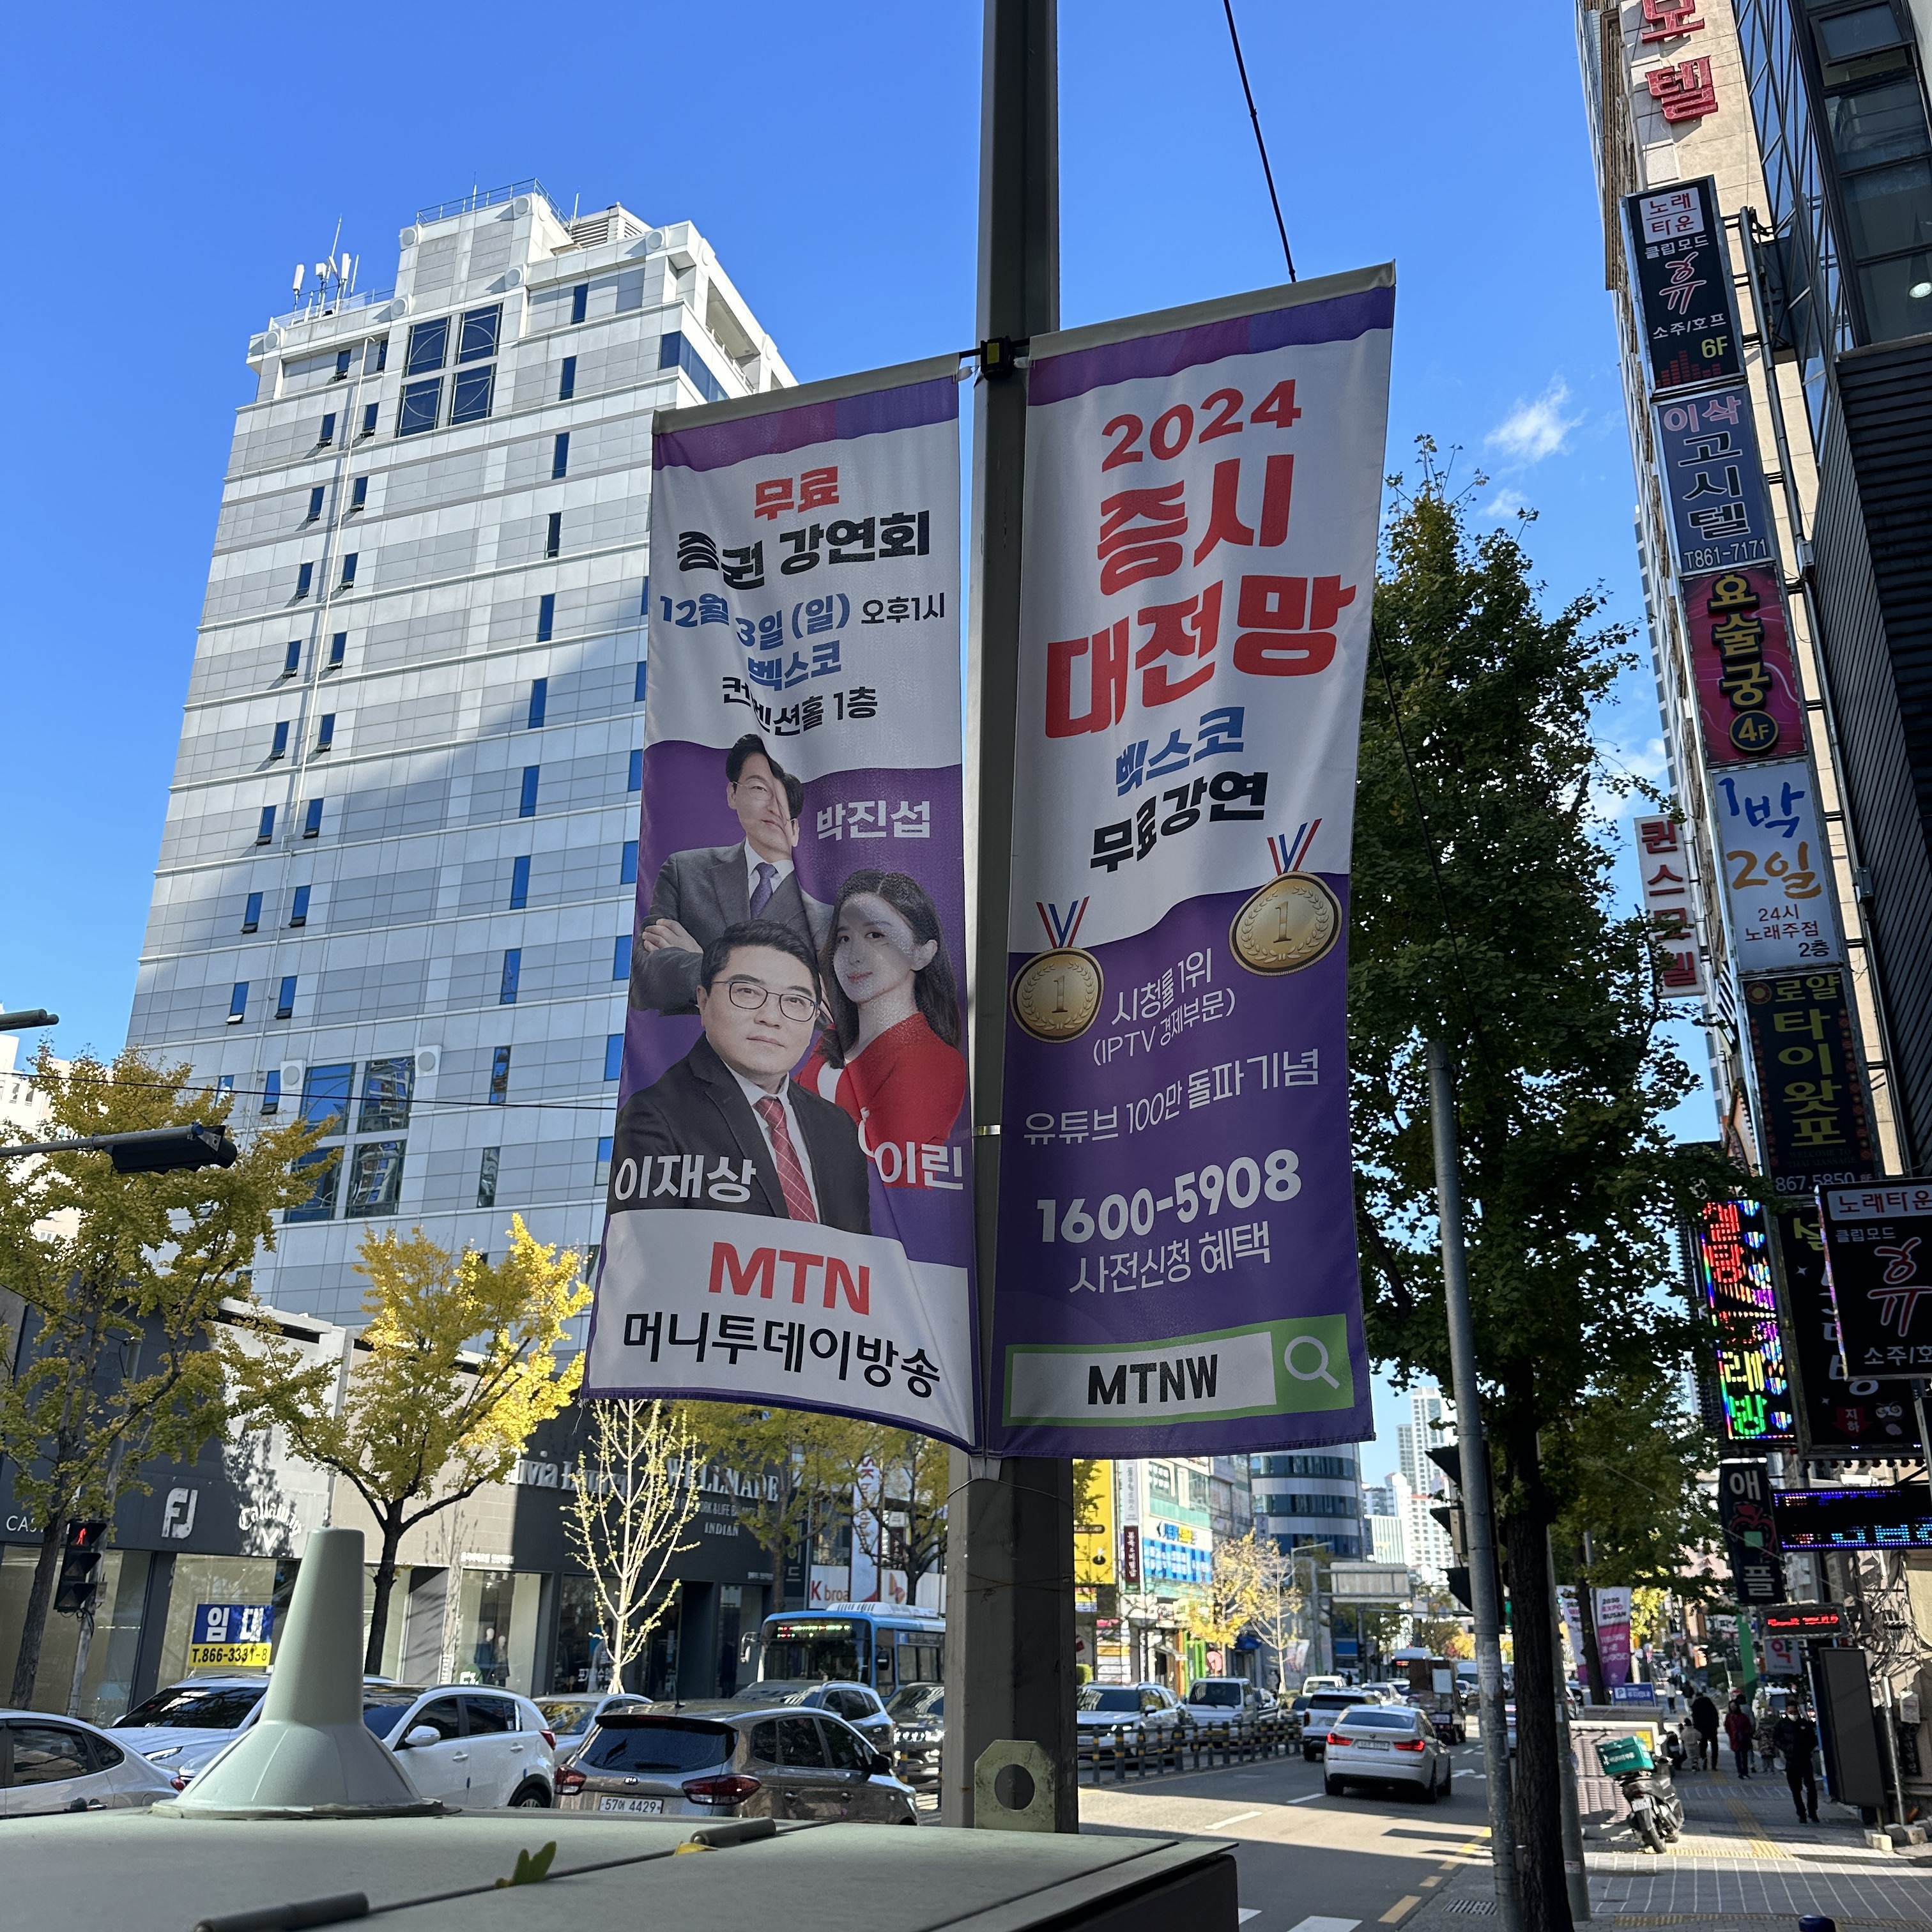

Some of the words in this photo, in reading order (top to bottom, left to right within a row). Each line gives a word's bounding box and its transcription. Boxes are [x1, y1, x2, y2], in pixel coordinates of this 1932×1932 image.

[1650, 192, 1692, 215] 노래
[1652, 216, 1694, 236] 타운
[1644, 234, 1710, 259] 클럽모드
[1653, 313, 1727, 340] 소주/호프
[1701, 335, 1728, 359] 6F
[1101, 379, 1301, 473] 2024
[1664, 395, 1742, 433] 이삭
[754, 466, 839, 521] 무료
[1678, 431, 1751, 542] 고시텔
[1097, 454, 1294, 595] 증시
[677, 531, 765, 590] 증권
[779, 510, 930, 575] 강연회
[1684, 539, 1767, 570] T861-7171
[660, 592, 730, 627] 12월
[736, 610, 784, 650] 3일
[792, 592, 850, 638] (일)
[861, 592, 945, 624] 오후1시
[1708, 573, 1772, 709] 요술궁
[747, 640, 842, 691] 벡스코
[1045, 574, 1356, 739] 대전망
[833, 686, 878, 721] 1층
[1116, 707, 1245, 797] 벡스코
[1738, 717, 1770, 742] 4F
[817, 800, 930, 841] 박진섭
[1718, 778, 1805, 838] 1박
[1726, 841, 1822, 900] 2일
[1275, 901, 1292, 944] 1
[1745, 920, 1819, 942] 노래주점
[1758, 903, 1800, 922] 24시
[1798, 940, 1830, 958] 2층
[1052, 975, 1068, 1014] 1
[1111, 967, 1174, 1026] 시청률
[1177, 948, 1212, 993] 1위
[1775, 975, 1841, 1002] 로얄
[1093, 1025, 1156, 1066] (IPTV
[1160, 988, 1236, 1046] 경제부문)
[1024, 1106, 1119, 1145] 유튜브
[1126, 1082, 1183, 1135] 100만
[1187, 1060, 1245, 1110] 돌파
[1247, 1048, 1319, 1087] 기념
[1773, 1009, 1846, 1147] 타이왓포
[615, 1154, 756, 1203] 이재상
[874, 1141, 963, 1190] 이린
[1037, 1149, 1301, 1244] 1600-5908
[1839, 1190, 1932, 1213] 노래타운
[709, 1241, 870, 1316] MTN
[1069, 1239, 1192, 1294] 사전신청
[1199, 1221, 1270, 1273] 혜택
[624, 1311, 940, 1399] 머니투데이방송
[1087, 1353, 1218, 1406] MTNW
[705, 1522, 739, 1537] INDIAN
[1730, 1470, 1774, 1597] 애플
[206, 1607, 264, 1641] 임대
[629, 1800, 657, 1813] 4429
